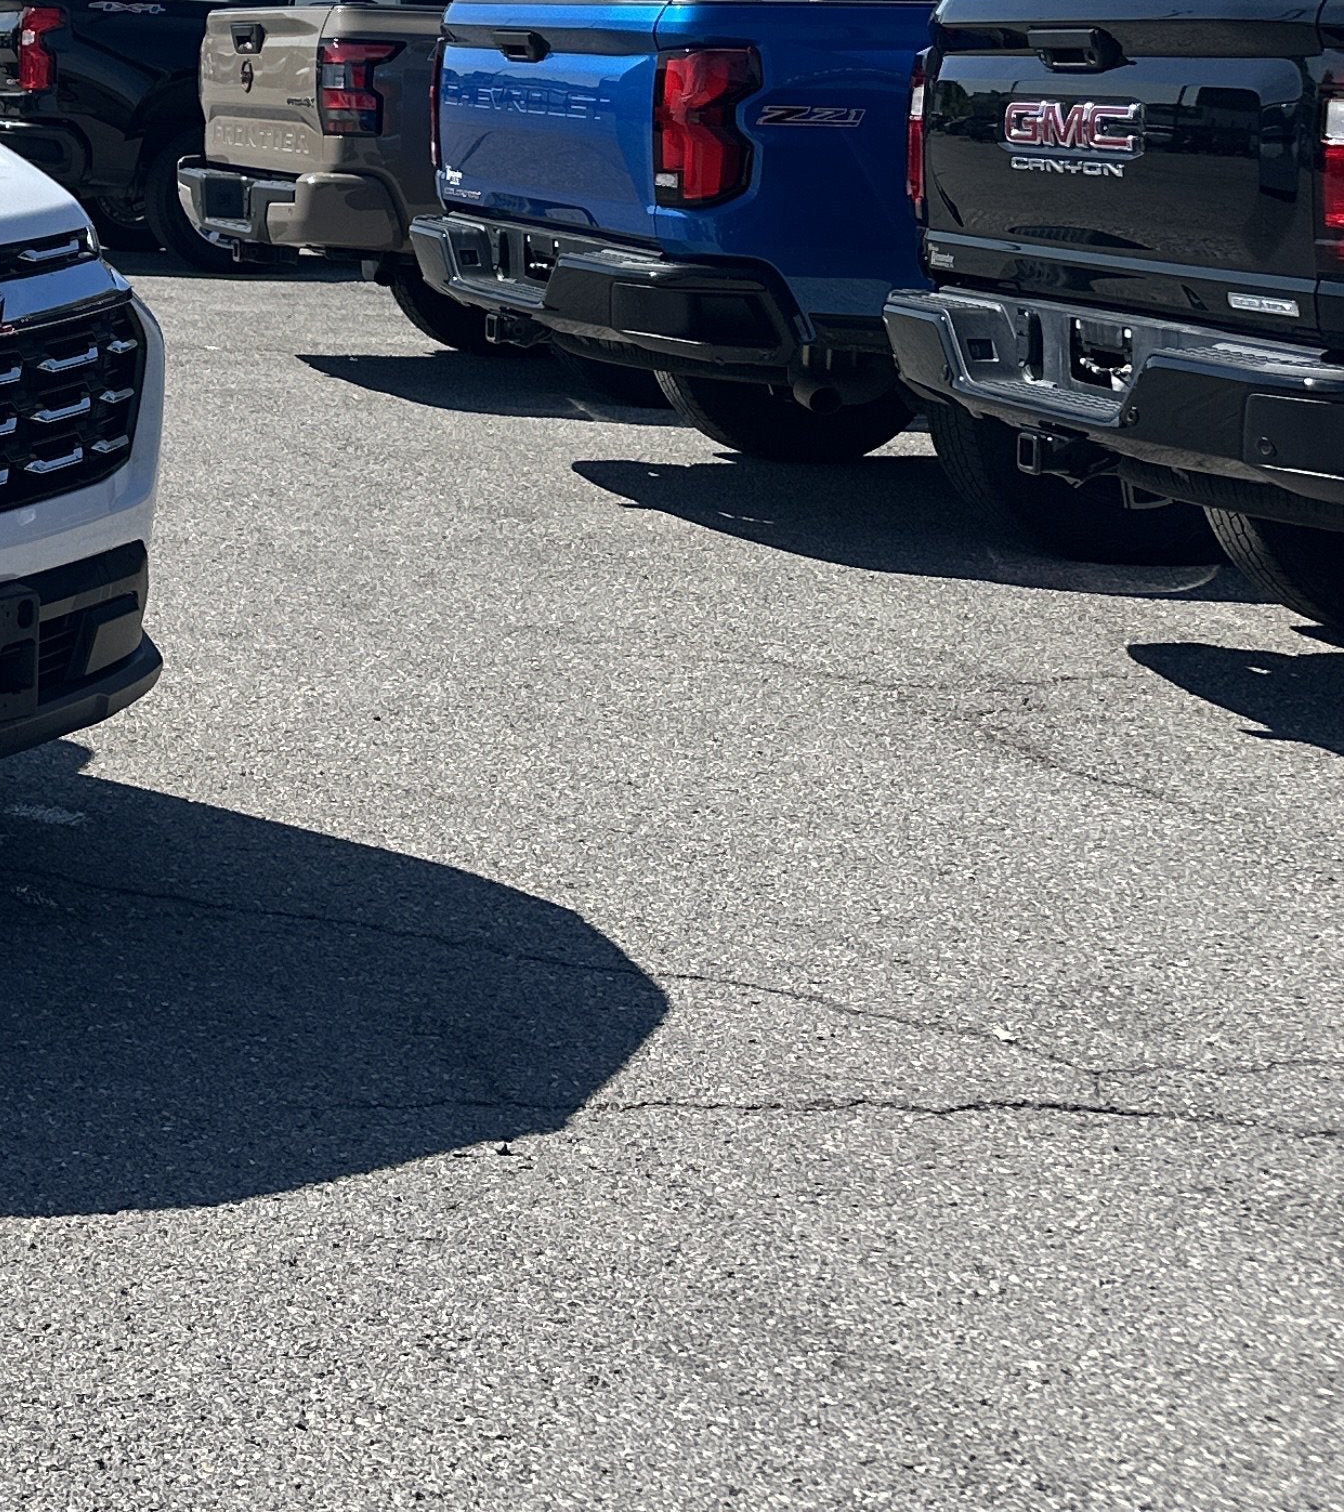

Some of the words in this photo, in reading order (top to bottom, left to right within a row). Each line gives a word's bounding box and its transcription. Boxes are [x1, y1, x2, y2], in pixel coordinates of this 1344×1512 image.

[443, 85, 611, 121] CHEVROLET
[755, 105, 867, 128] Z71
[213, 122, 311, 155] FRONTIER
[1004, 100, 1135, 152] GMC
[1010, 156, 1126, 179] CANYON
